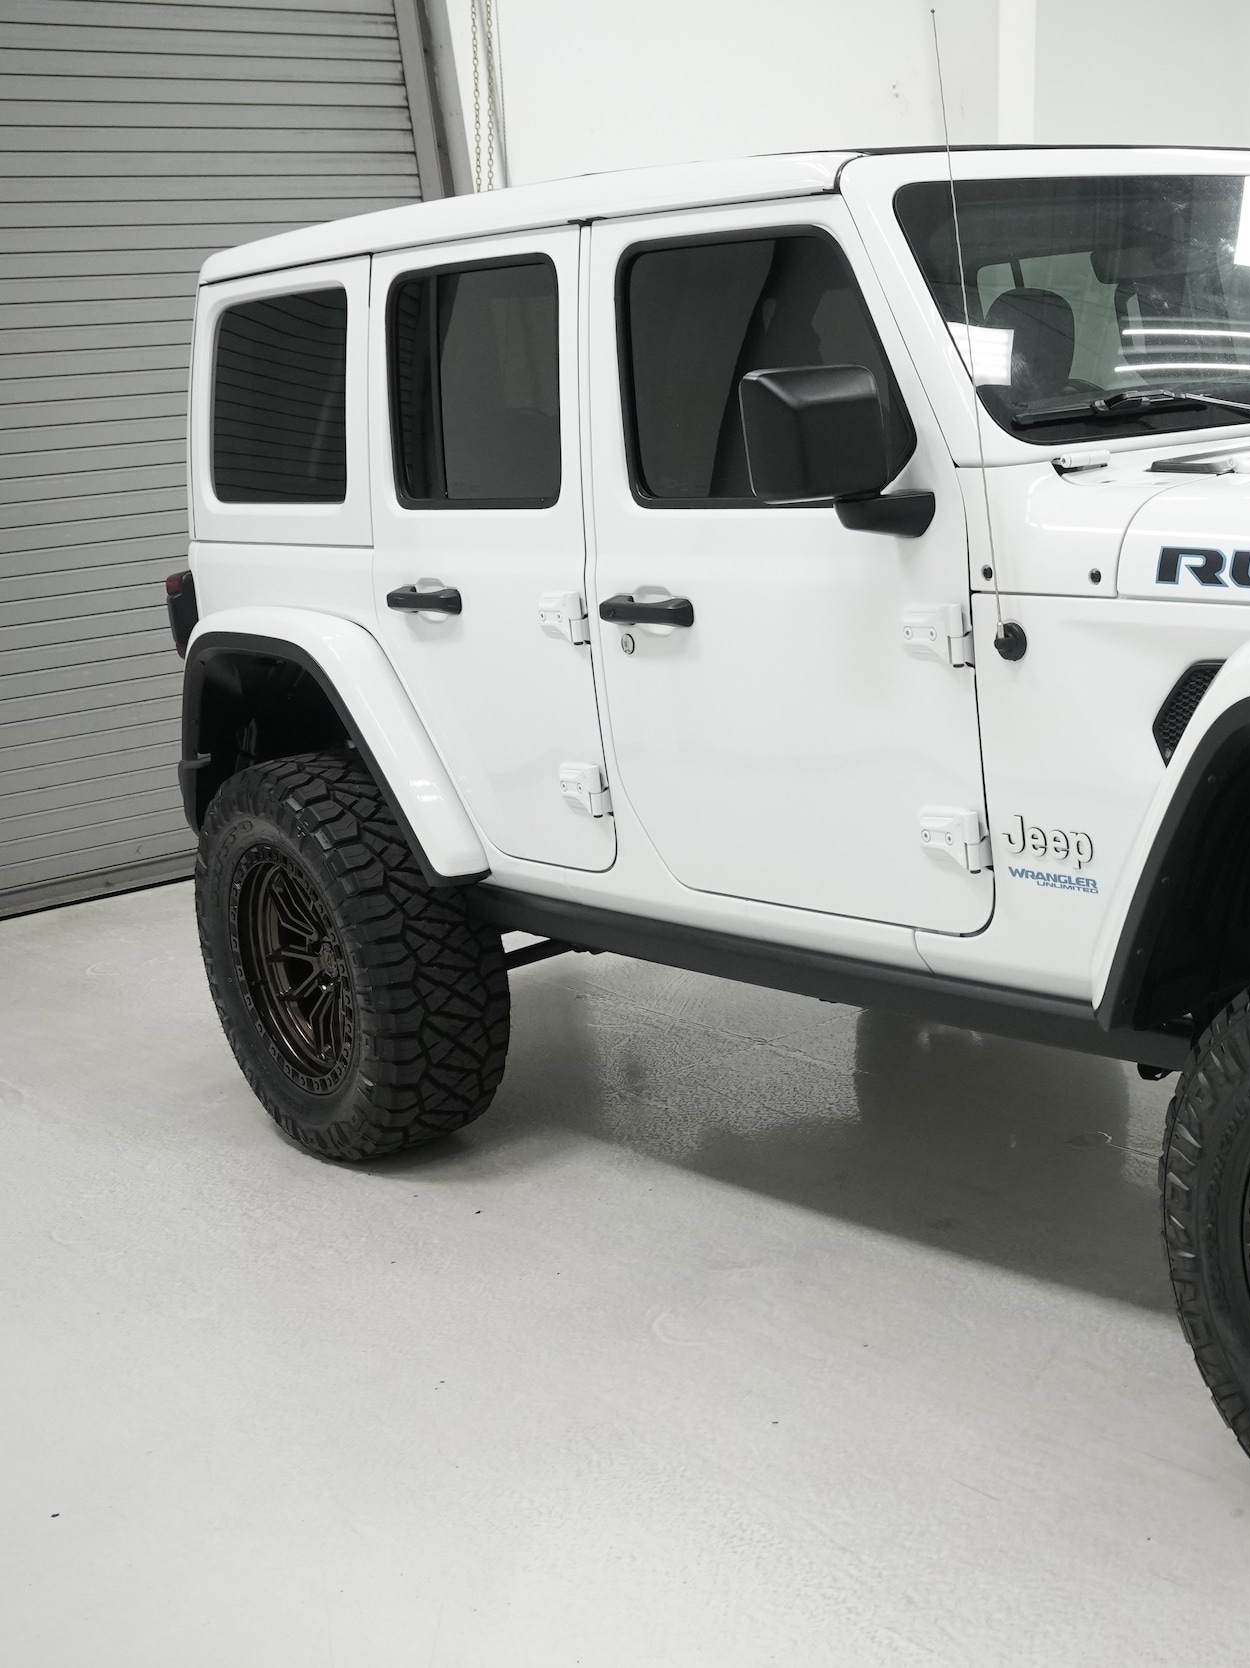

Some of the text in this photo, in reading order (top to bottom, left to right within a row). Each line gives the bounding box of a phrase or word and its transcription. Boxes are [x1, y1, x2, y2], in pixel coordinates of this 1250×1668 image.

[1002, 814, 1094, 870] Jeep
[1008, 866, 1098, 889] WRANGLER
[1036, 880, 1099, 894] UNLIMITED
